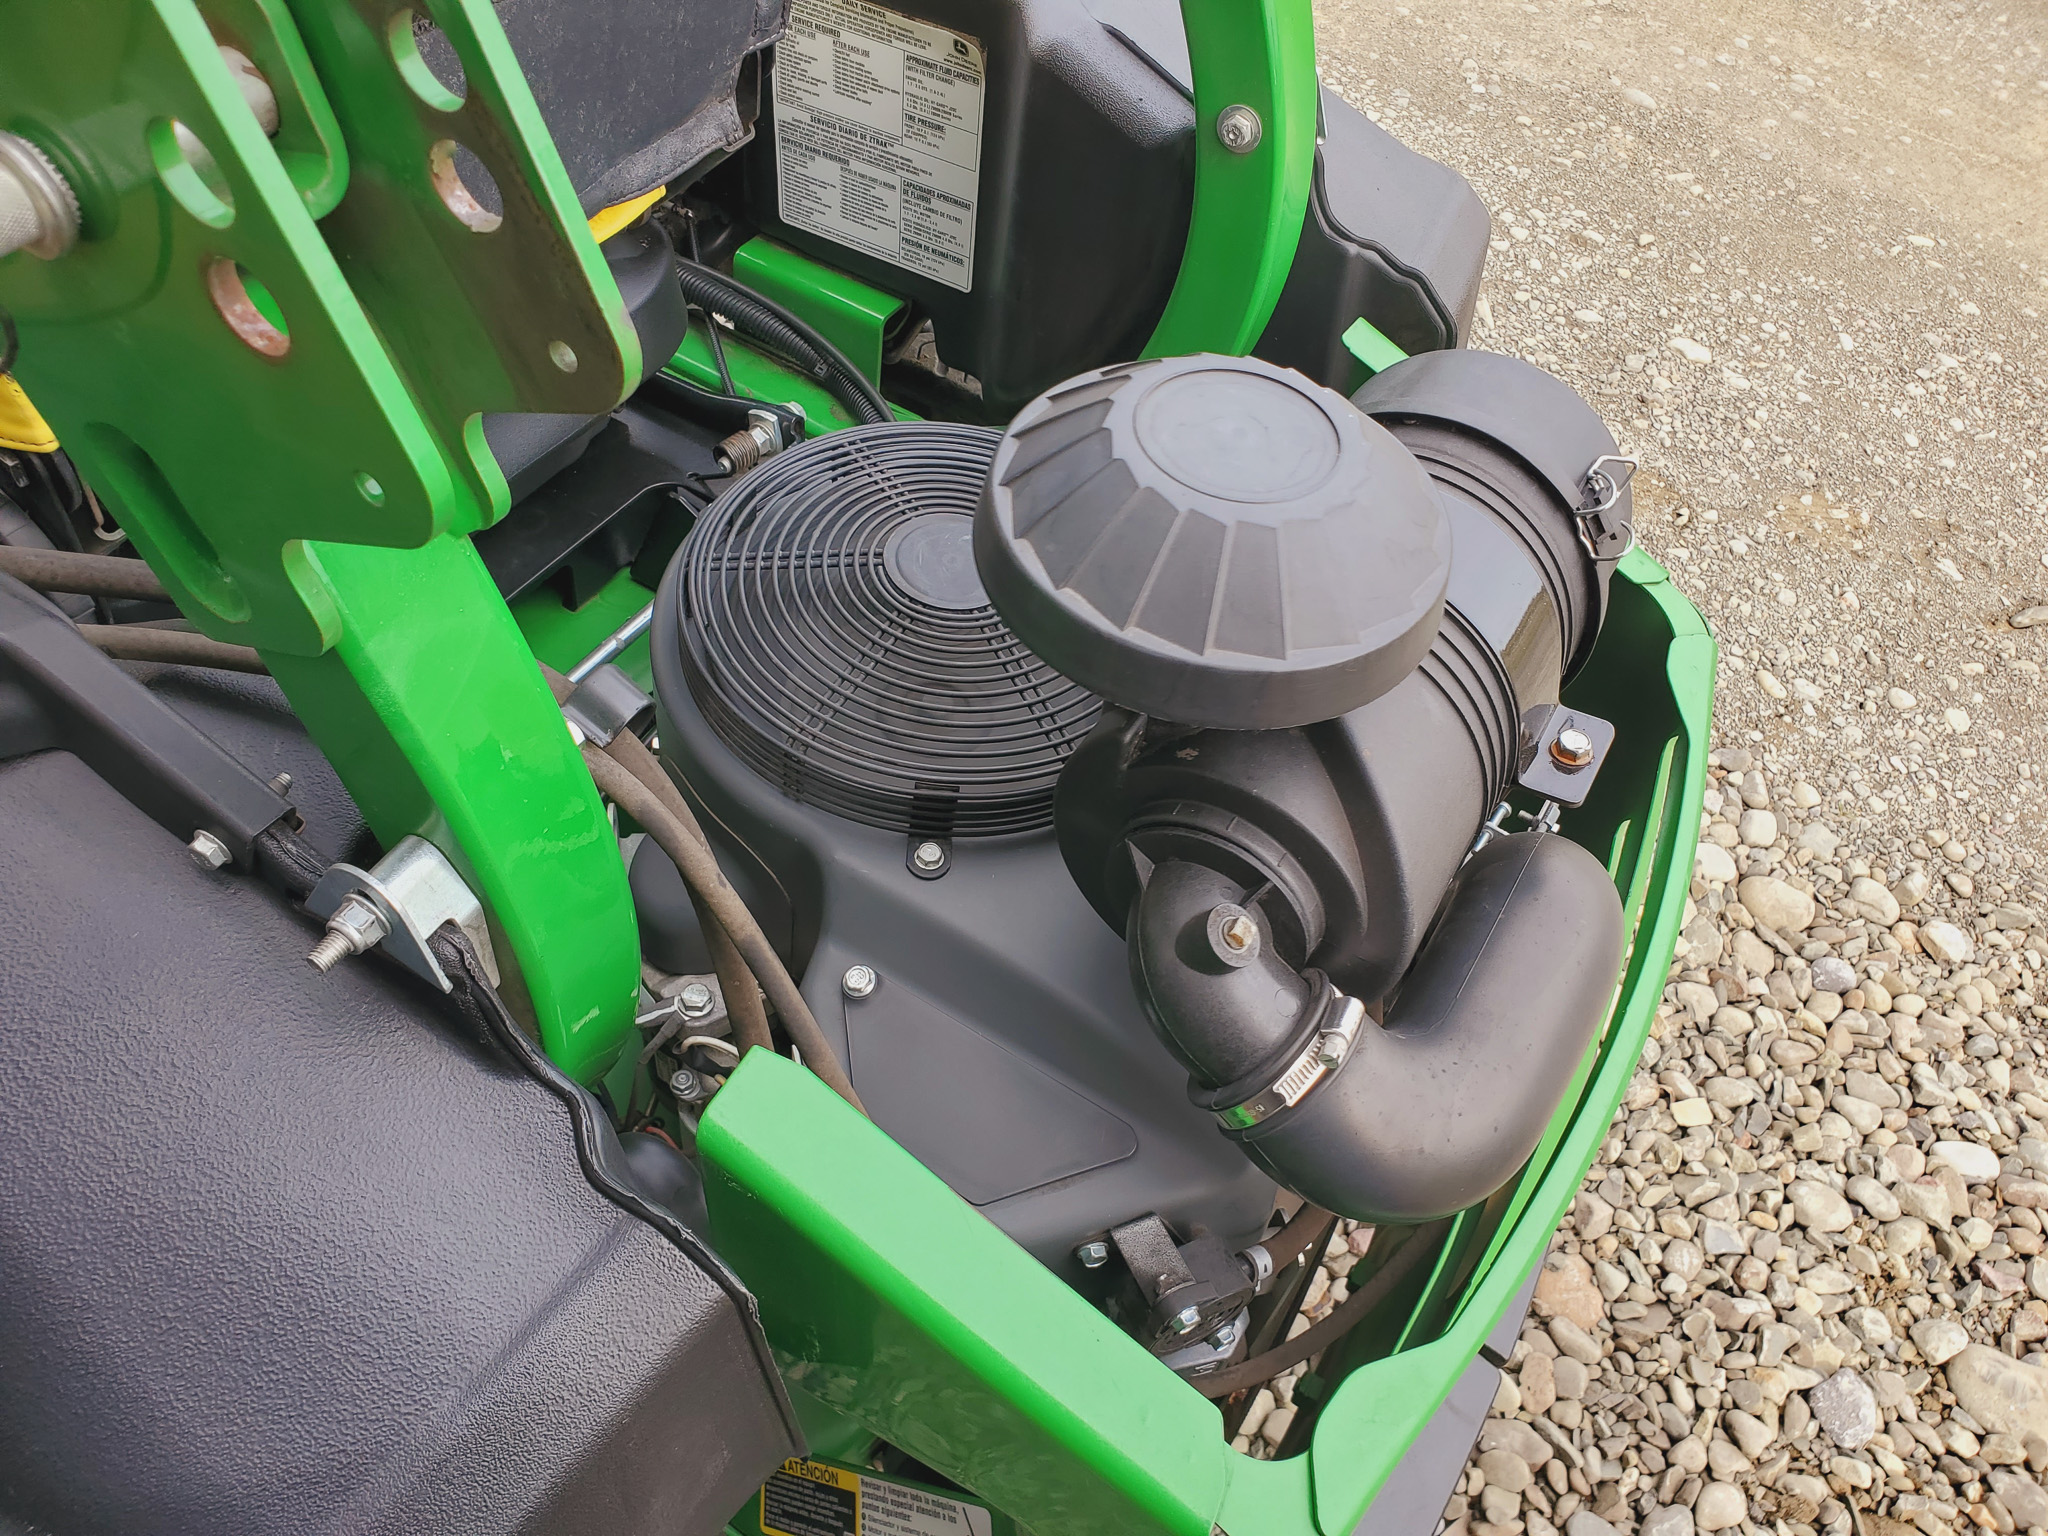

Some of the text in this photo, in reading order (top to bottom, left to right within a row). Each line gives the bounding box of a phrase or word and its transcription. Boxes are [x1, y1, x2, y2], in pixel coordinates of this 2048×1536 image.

[841, 0, 886, 18] DAILY SERVICE
[791, 14, 813, 28] SERVICE
[814, 22, 840, 38] REQUIRED
[794, 26, 806, 36] EACH
[806, 30, 815, 39] USE
[832, 38, 870, 57] AFTER EACH USE
[905, 64, 955, 87] (WITH FILTER CHANGE)
[906, 53, 979, 85] APPROXIMATE FLUID CAPACITIES
[809, 114, 836, 131] SERVICIO
[838, 125, 858, 138] DIARIO
[859, 132, 867, 142] DE
[868, 135, 894, 151] ZTRAK™
[904, 112, 946, 133] TIRE PRESSURE:
[781, 135, 803, 149] SERVICIO
[804, 144, 821, 155] DIARIO
[822, 150, 849, 166] REQUERIDO
[781, 144, 792, 152] ANTES
[798, 150, 807, 158] CADA
[902, 179, 970, 210] CAPACIDADES APROXIMADAS
[902, 187, 931, 204] DE FLUIDOS
[902, 197, 921, 210] (INCLUYE
[922, 204, 938, 216] CAMBIO
[946, 213, 962, 224] FILTRO)
[901, 235, 922, 249] PRESIÓN
[923, 244, 930, 252] DE
[931, 246, 964, 265] NEUMÁTICOS:
[788, 1458, 838, 1485] ATENCIÓN
[860, 1478, 880, 1491] Revisar
[883, 1486, 885, 1495] y
[887, 1485, 908, 1500] limpiar
[909, 1491, 922, 1502] toda
[924, 1496, 929, 1505] la
[861, 1489, 888, 1505] prestando
[890, 1495, 914, 1512] especial
[916, 1503, 940, 1519] atención
[947, 1512, 956, 1523] los
[861, 1500, 911, 1522] puntos siguientes:
